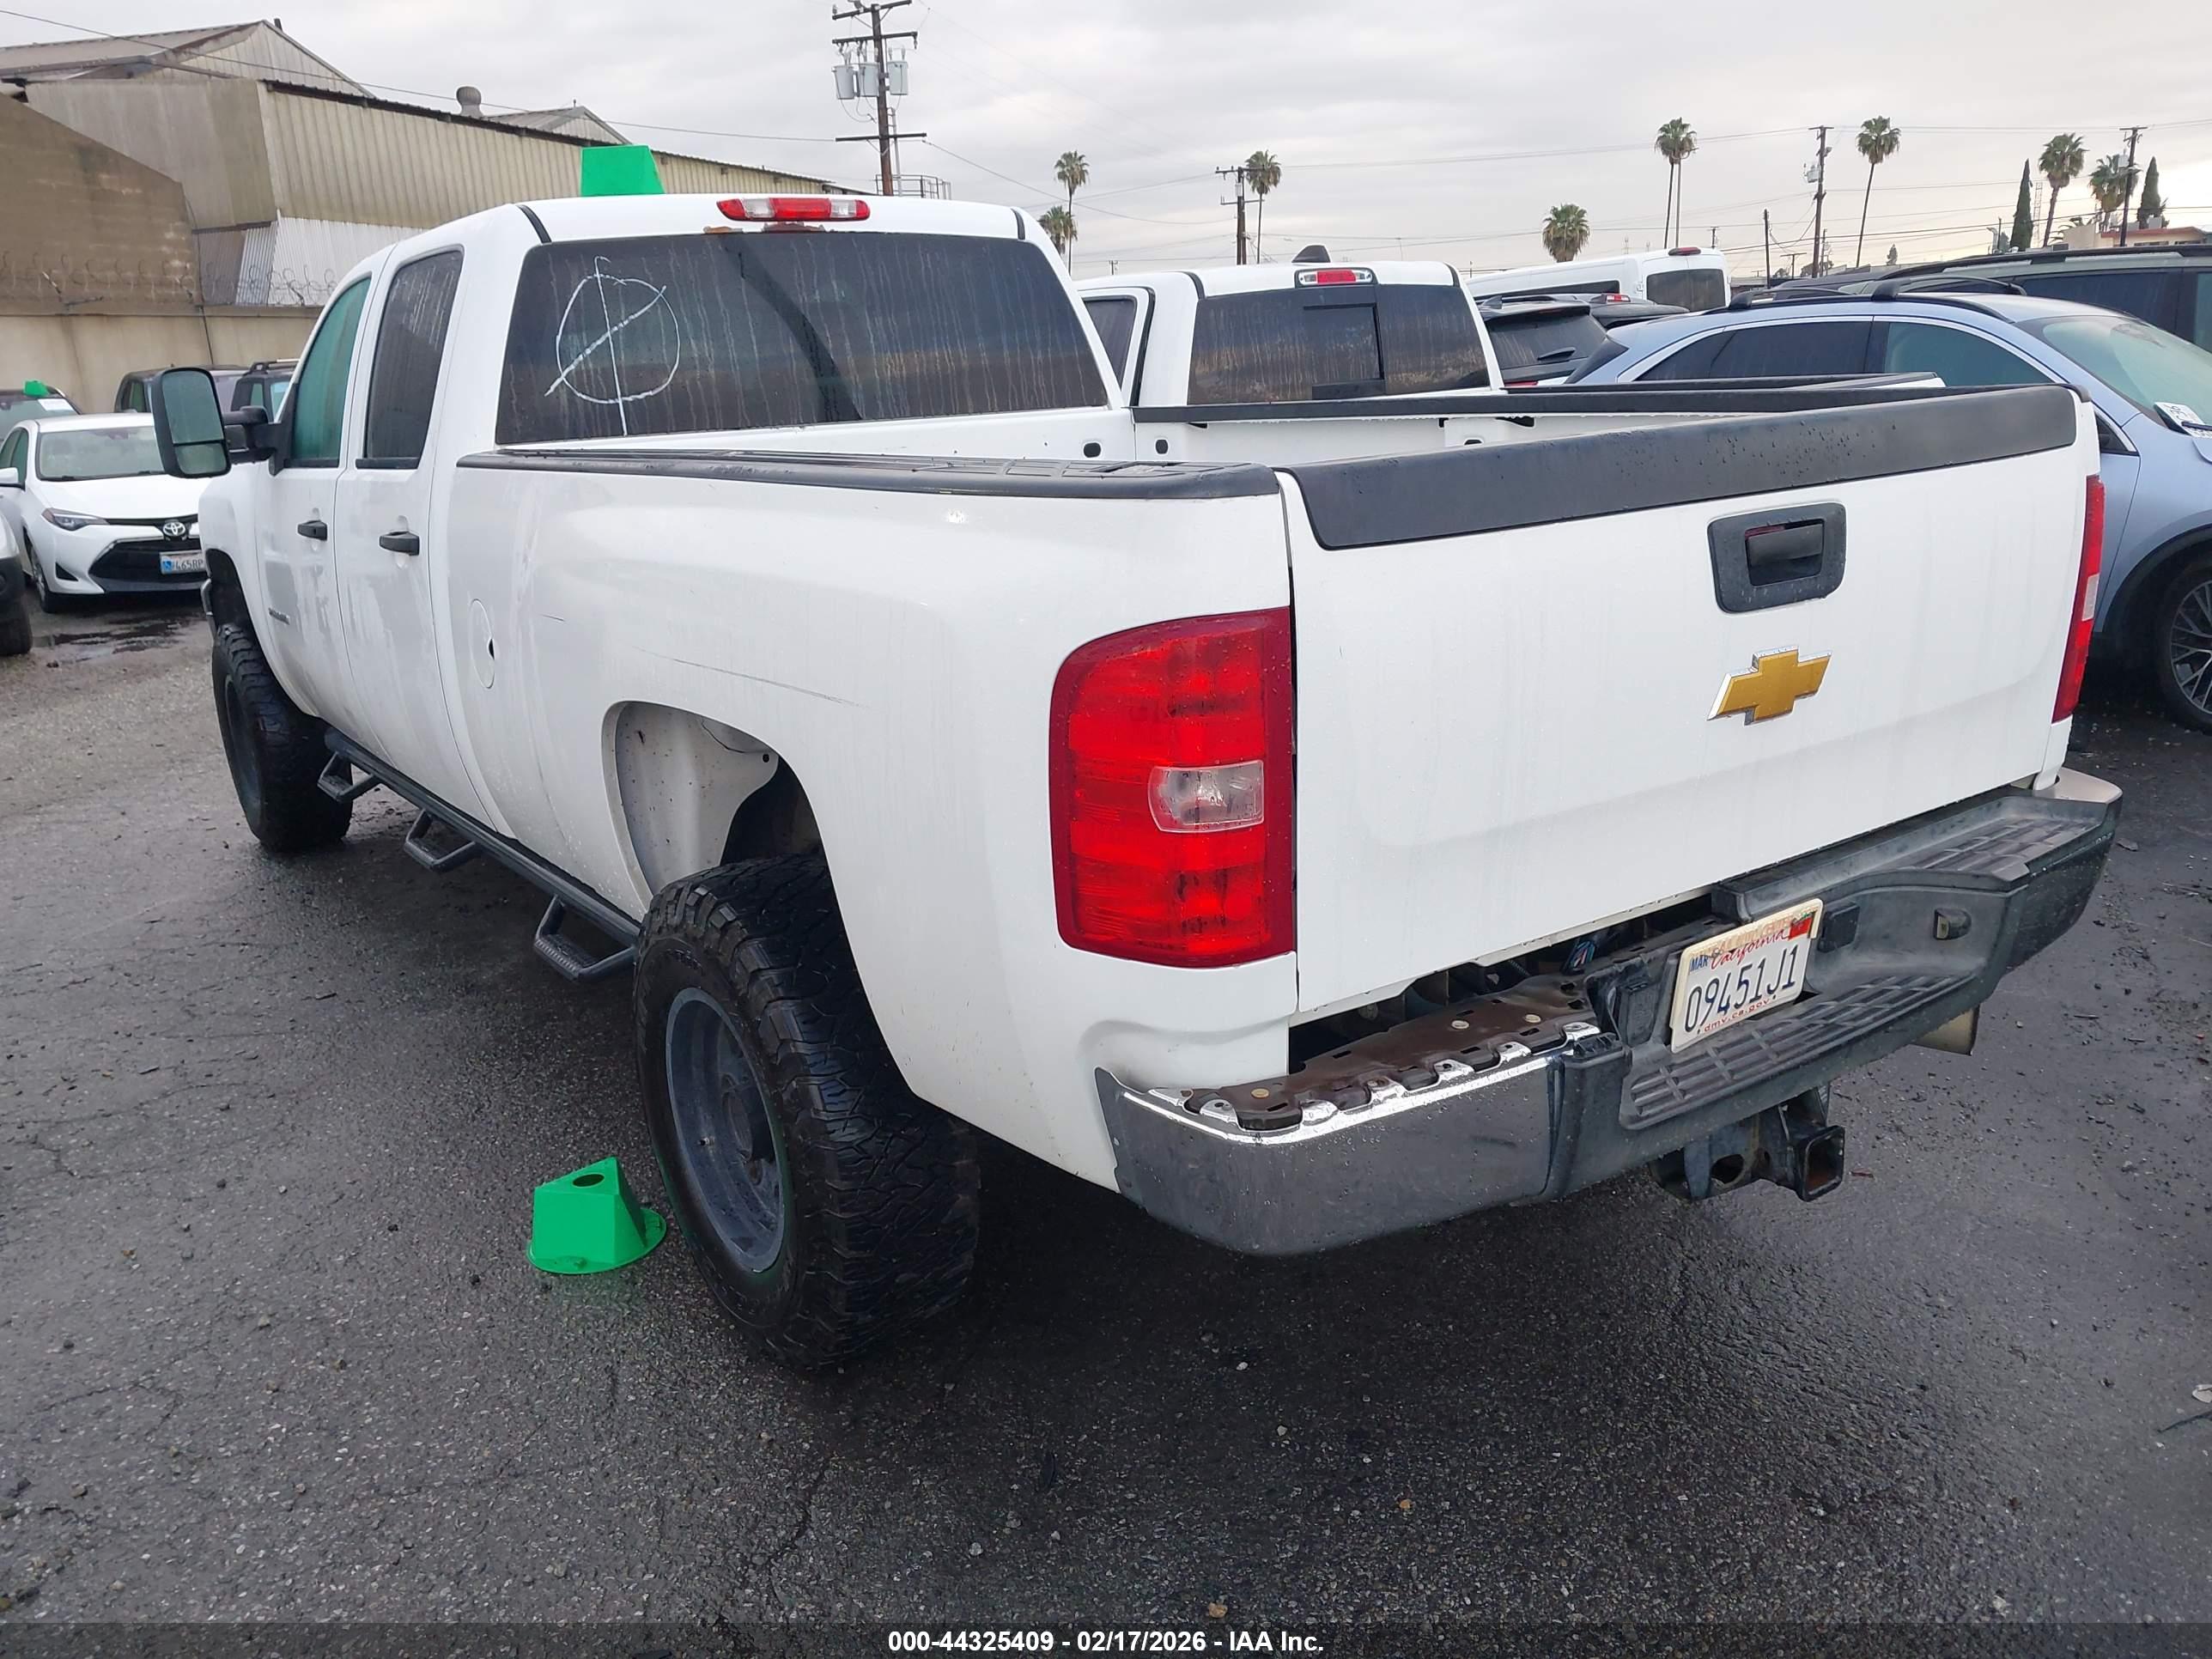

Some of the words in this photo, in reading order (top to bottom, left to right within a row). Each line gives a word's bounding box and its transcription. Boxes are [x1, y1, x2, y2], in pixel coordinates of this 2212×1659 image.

[1689, 956, 1708, 971] MAR
[1711, 928, 1790, 969] California
[1684, 944, 1798, 1033] 09451J1
[1704, 1000, 1771, 1033] dmv.ca.gov
